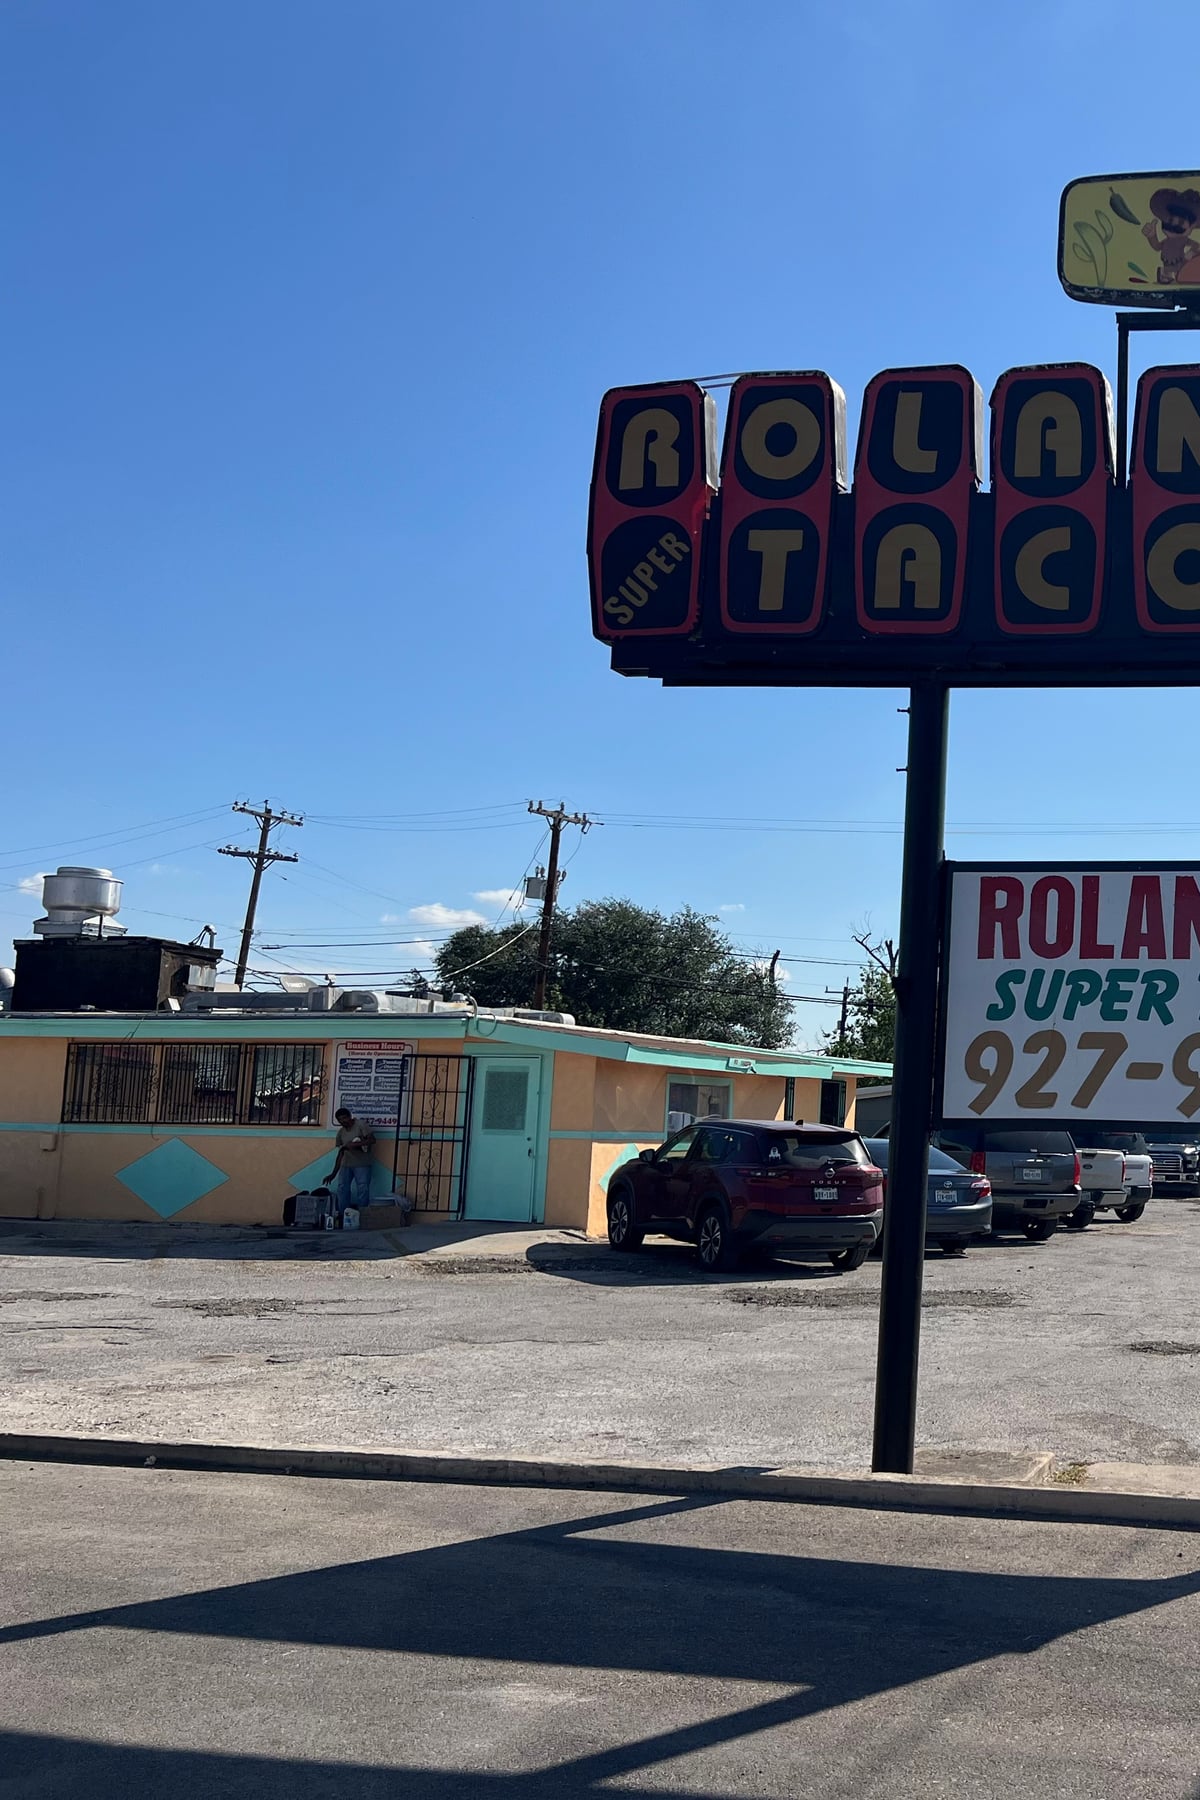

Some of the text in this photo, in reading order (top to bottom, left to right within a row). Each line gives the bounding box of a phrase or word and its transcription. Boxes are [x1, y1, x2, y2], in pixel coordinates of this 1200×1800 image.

[604, 532, 690, 625] SUPER
[986, 968, 1180, 1026] SUPER
[381, 1042, 404, 1050] Hours
